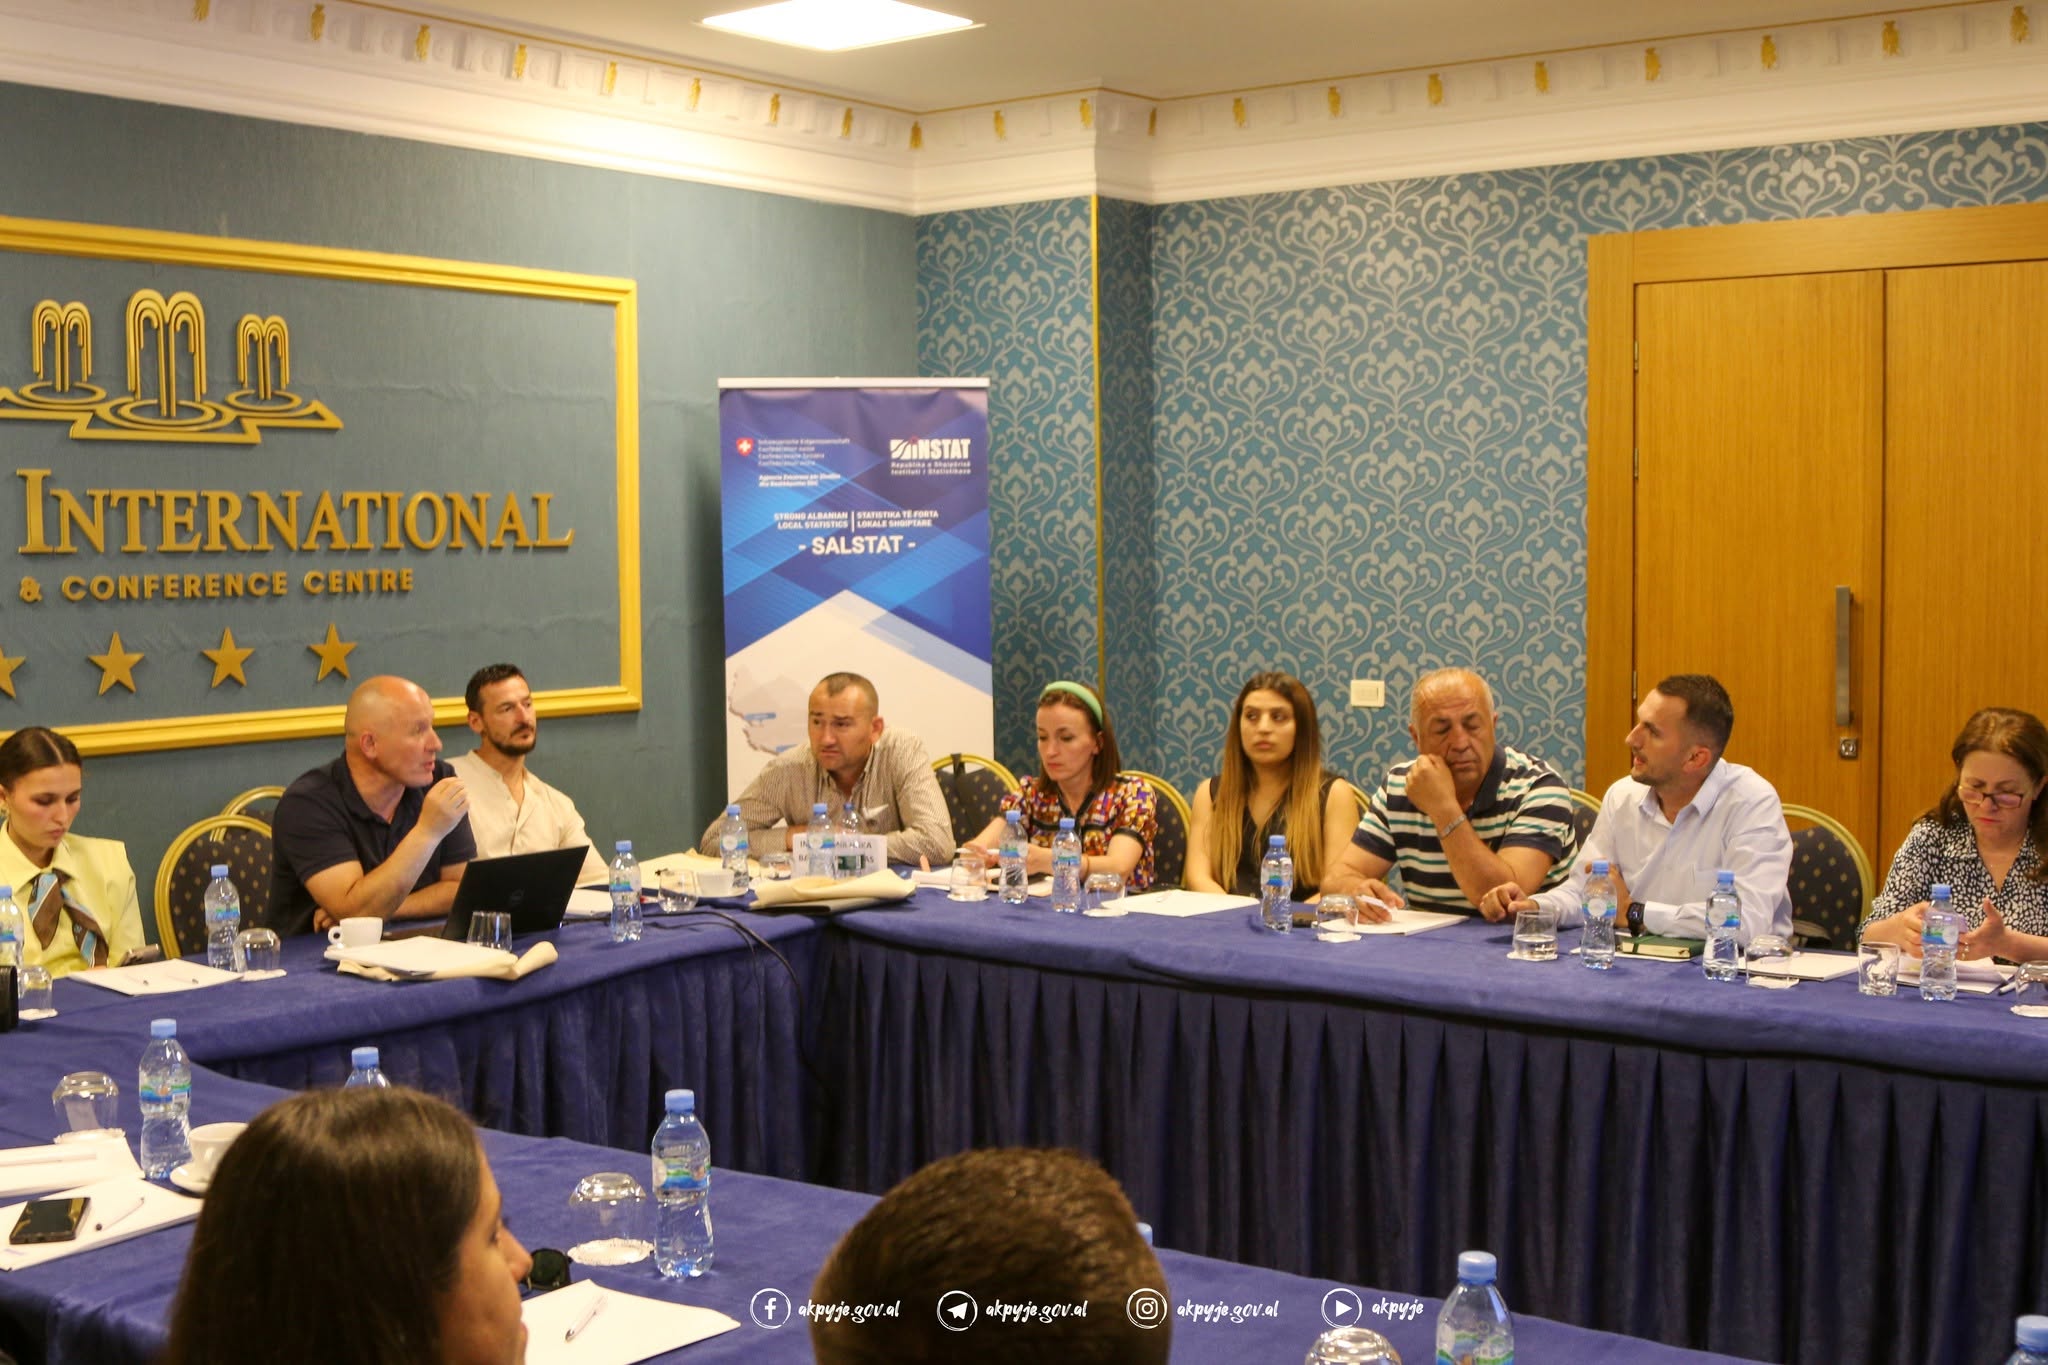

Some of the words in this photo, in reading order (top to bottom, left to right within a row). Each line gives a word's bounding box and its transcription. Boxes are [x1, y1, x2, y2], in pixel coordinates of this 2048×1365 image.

[16, 468, 575, 555] INTERNATIONAL
[774, 512, 807, 521] STRONG
[807, 511, 848, 520] ALBANIAN
[857, 511, 900, 519] STATISTIKA
[914, 510, 939, 519] FORTA
[777, 521, 804, 530] LOCAL
[805, 520, 849, 529] STATISTICS
[857, 519, 888, 528] LOKALE
[888, 519, 933, 528] SHQIPTARE
[811, 535, 904, 555] SALSTAT
[19, 577, 41, 602] &
[61, 571, 288, 601] CONFERENCE
[303, 568, 415, 595] CENTRE
